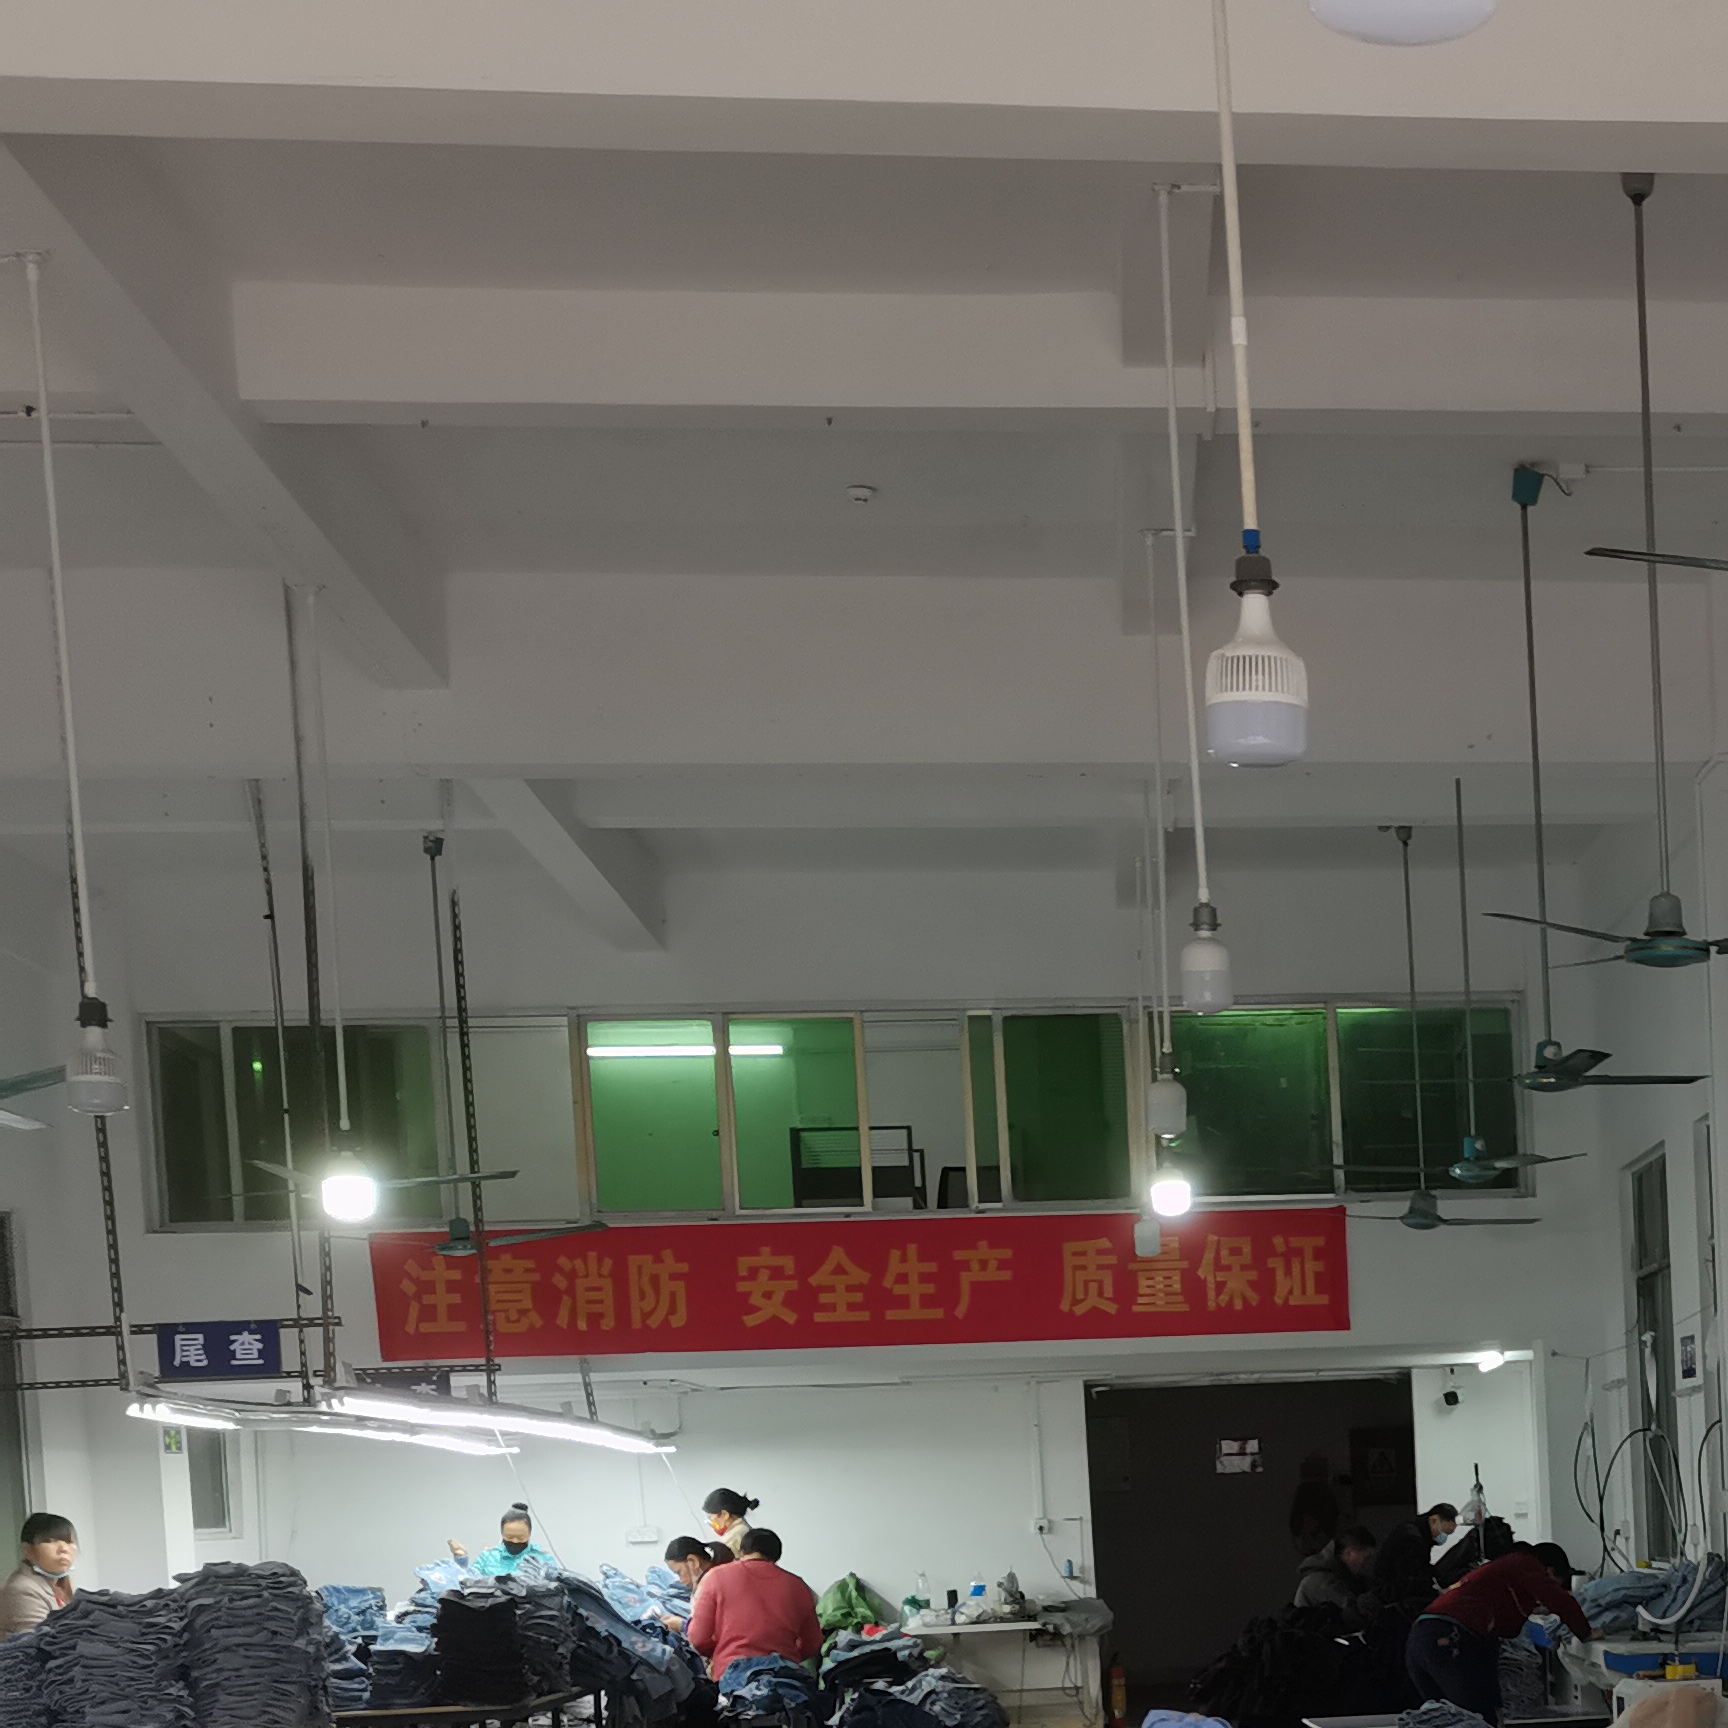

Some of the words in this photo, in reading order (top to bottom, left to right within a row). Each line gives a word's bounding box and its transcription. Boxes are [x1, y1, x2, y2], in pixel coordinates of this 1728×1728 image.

[401, 1248, 689, 1334] 注意消防
[735, 1241, 1013, 1327] 安全生产
[1059, 1234, 1330, 1317] 质量保证
[172, 1331, 265, 1367] 尾查
